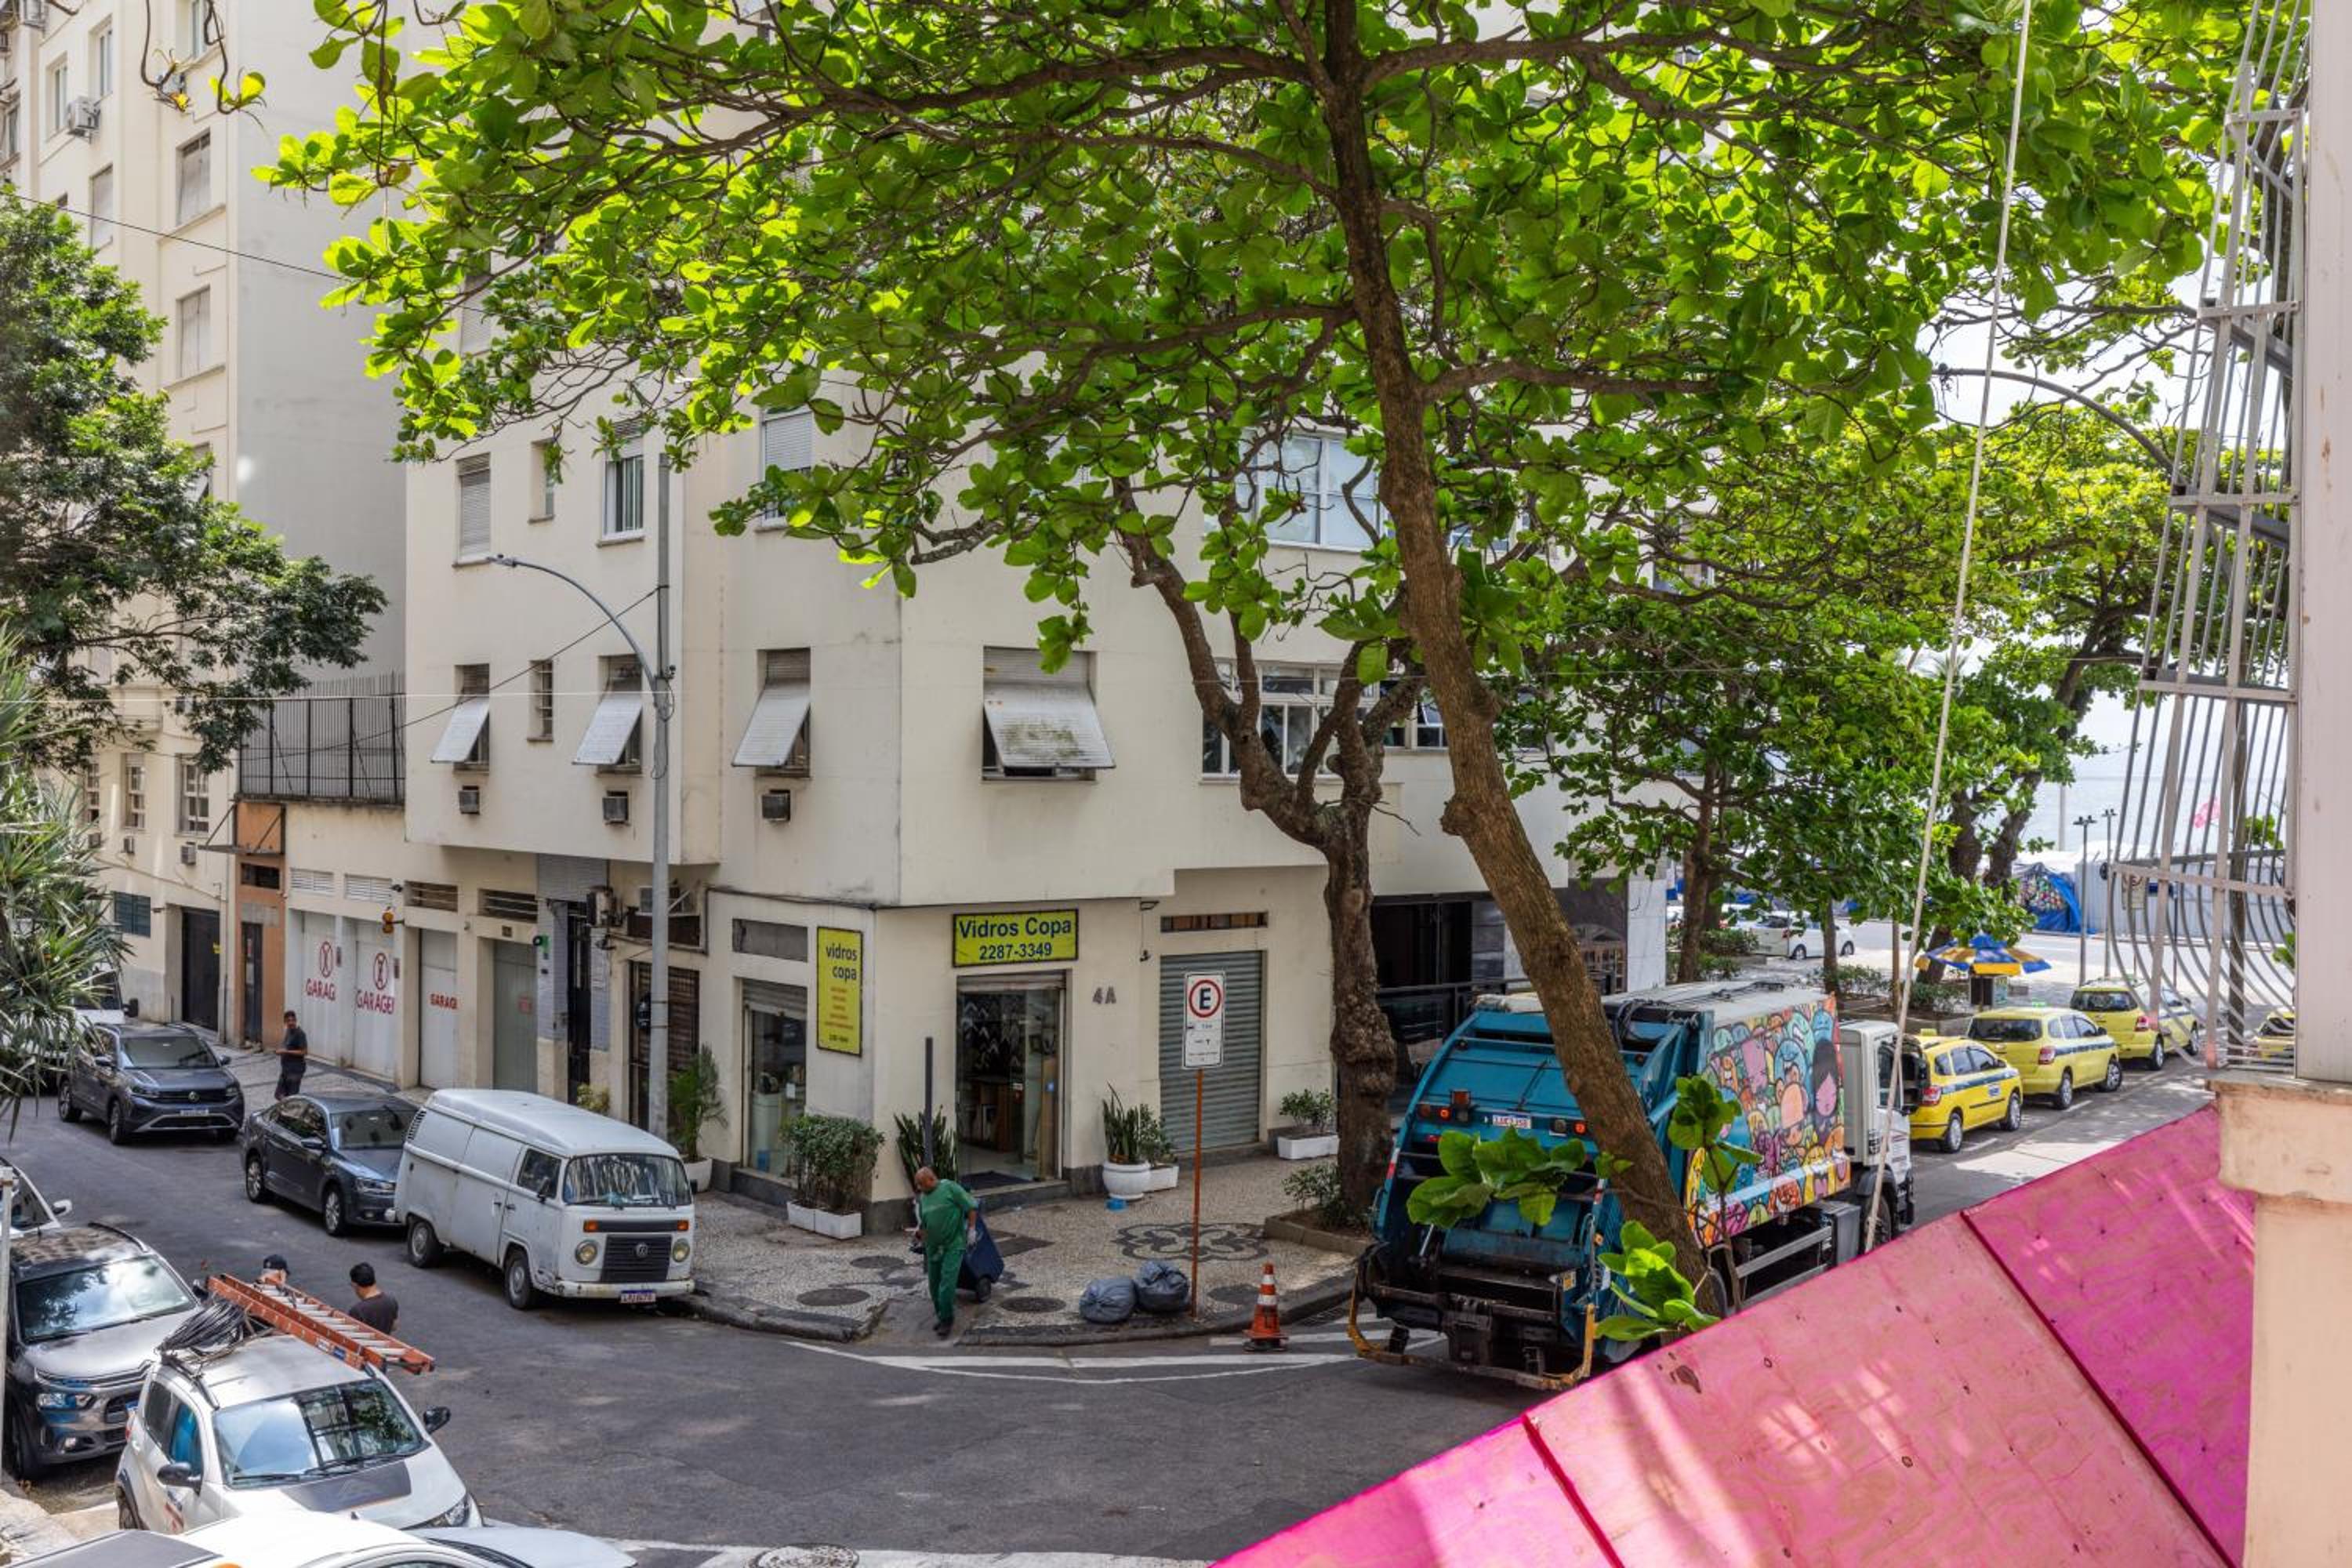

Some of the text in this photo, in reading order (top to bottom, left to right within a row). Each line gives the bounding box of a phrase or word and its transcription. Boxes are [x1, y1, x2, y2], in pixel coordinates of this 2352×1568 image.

[959, 916, 1072, 938] Vidros Copa
[826, 943, 857, 961] vidros
[979, 942, 1052, 960] 2287-3349
[832, 965, 857, 984] copa
[306, 978, 336, 1001] GARAG
[430, 993, 458, 1010] GARAG
[1200, 988, 1211, 1011] E
